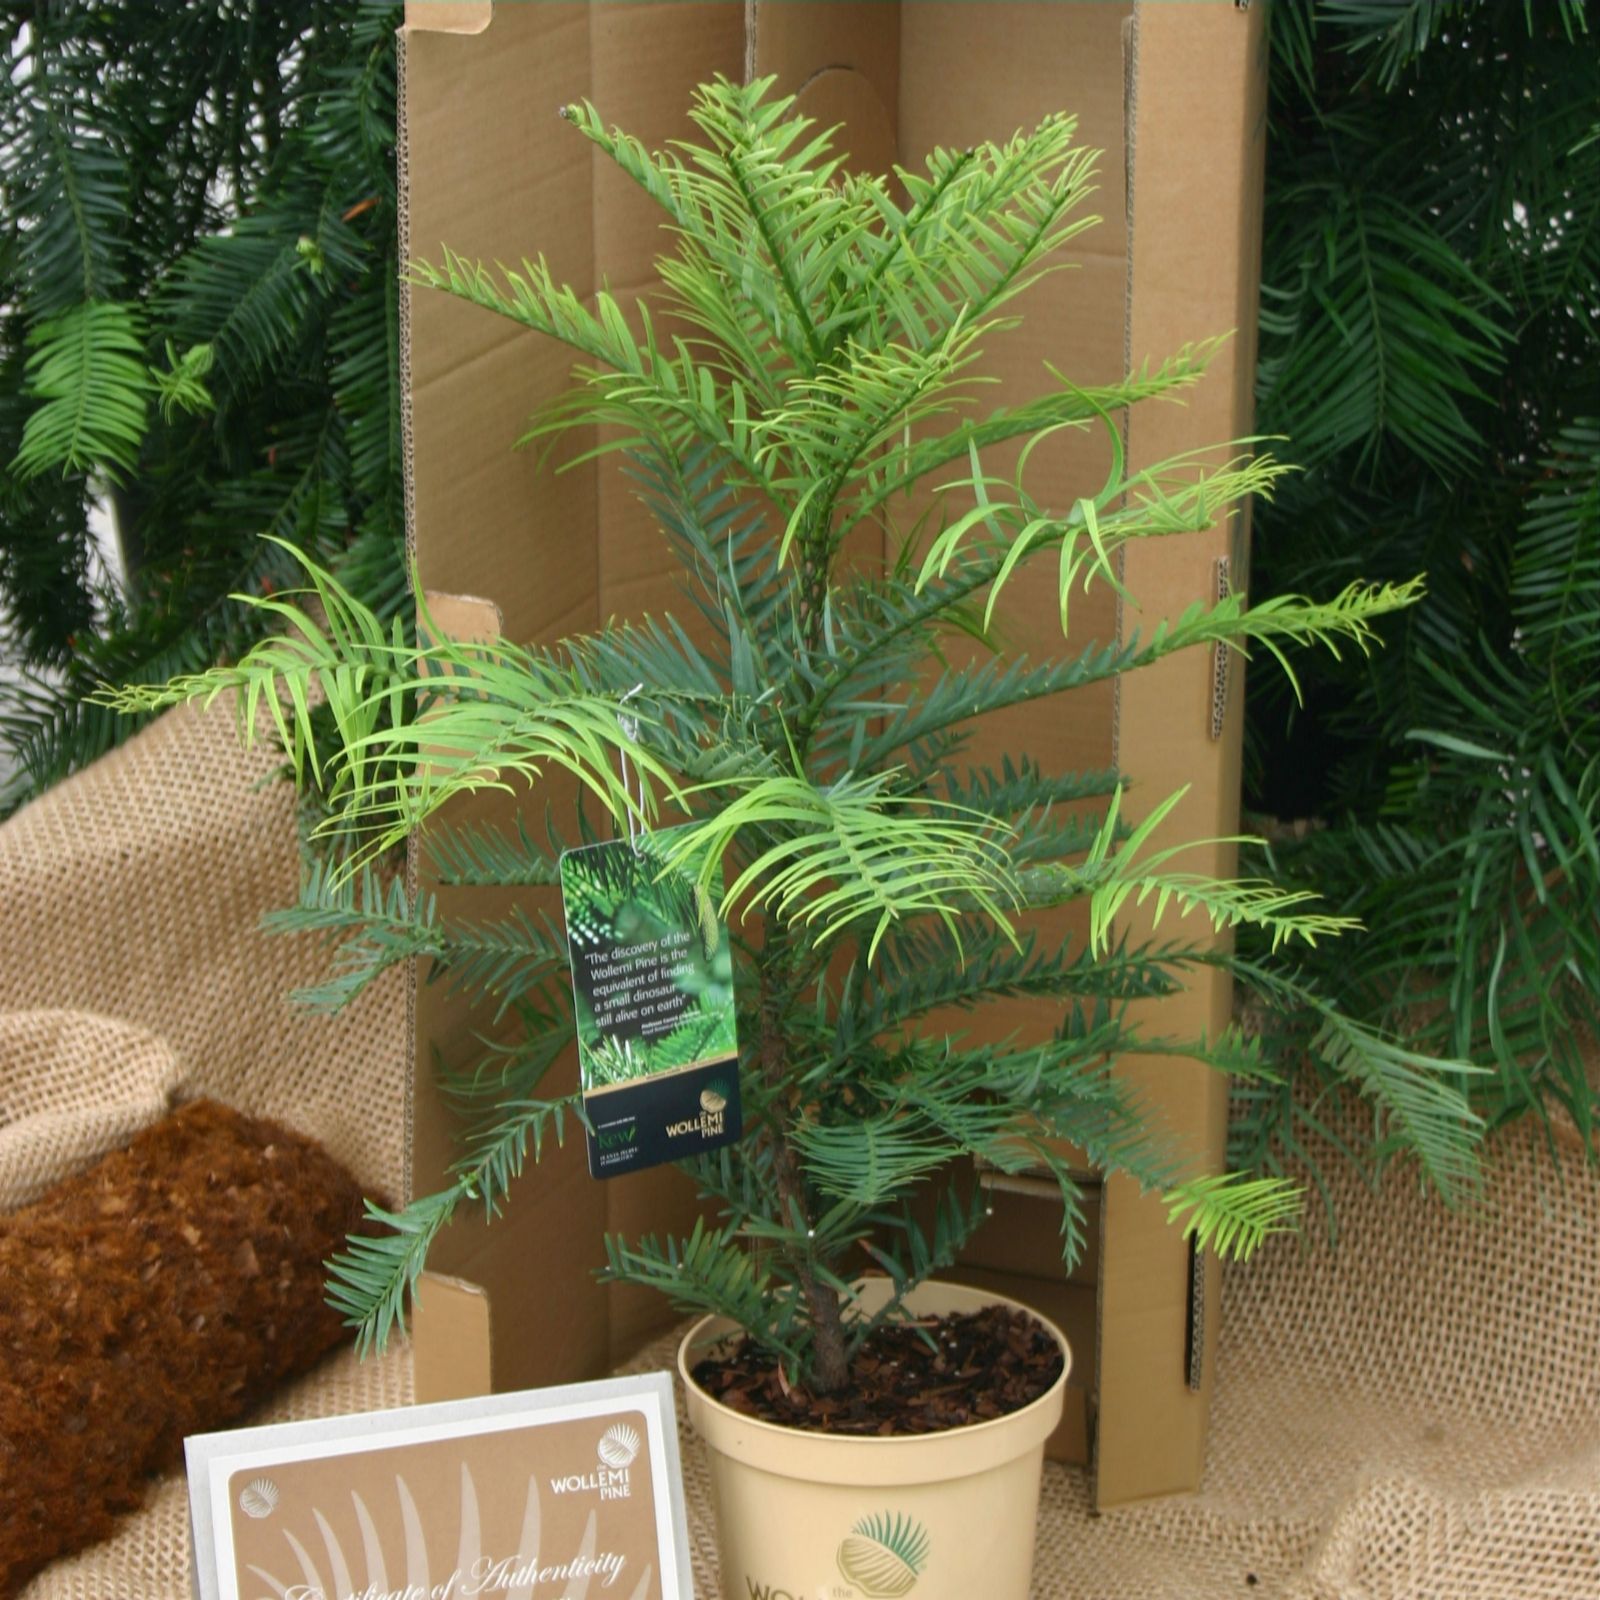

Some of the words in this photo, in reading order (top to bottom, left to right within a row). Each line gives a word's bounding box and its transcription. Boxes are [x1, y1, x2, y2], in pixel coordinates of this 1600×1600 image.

[611, 940, 658, 960] discovery
[660, 934, 671, 948] of
[673, 931, 690, 946] the
[590, 962, 633, 981] Wollemi
[635, 957, 657, 970] Pine
[660, 953, 668, 964] is
[671, 948, 688, 961] the
[592, 976, 645, 997] equivalent
[647, 970, 658, 983] of
[660, 961, 695, 979] finding
[594, 1003, 601, 1013] a
[603, 996, 631, 1011] small
[633, 985, 676, 1003] dinosaur
[595, 1014, 612, 1028] still
[615, 1010, 638, 1023] alive
[641, 1005, 654, 1016] on
[665, 1111, 723, 1139] WOLLEMI
[701, 1124, 724, 1139] PINE
[550, 1468, 629, 1494] WOLLEMI
[600, 1484, 631, 1501] PINE
[461, 1552, 626, 1595] Authenticity
